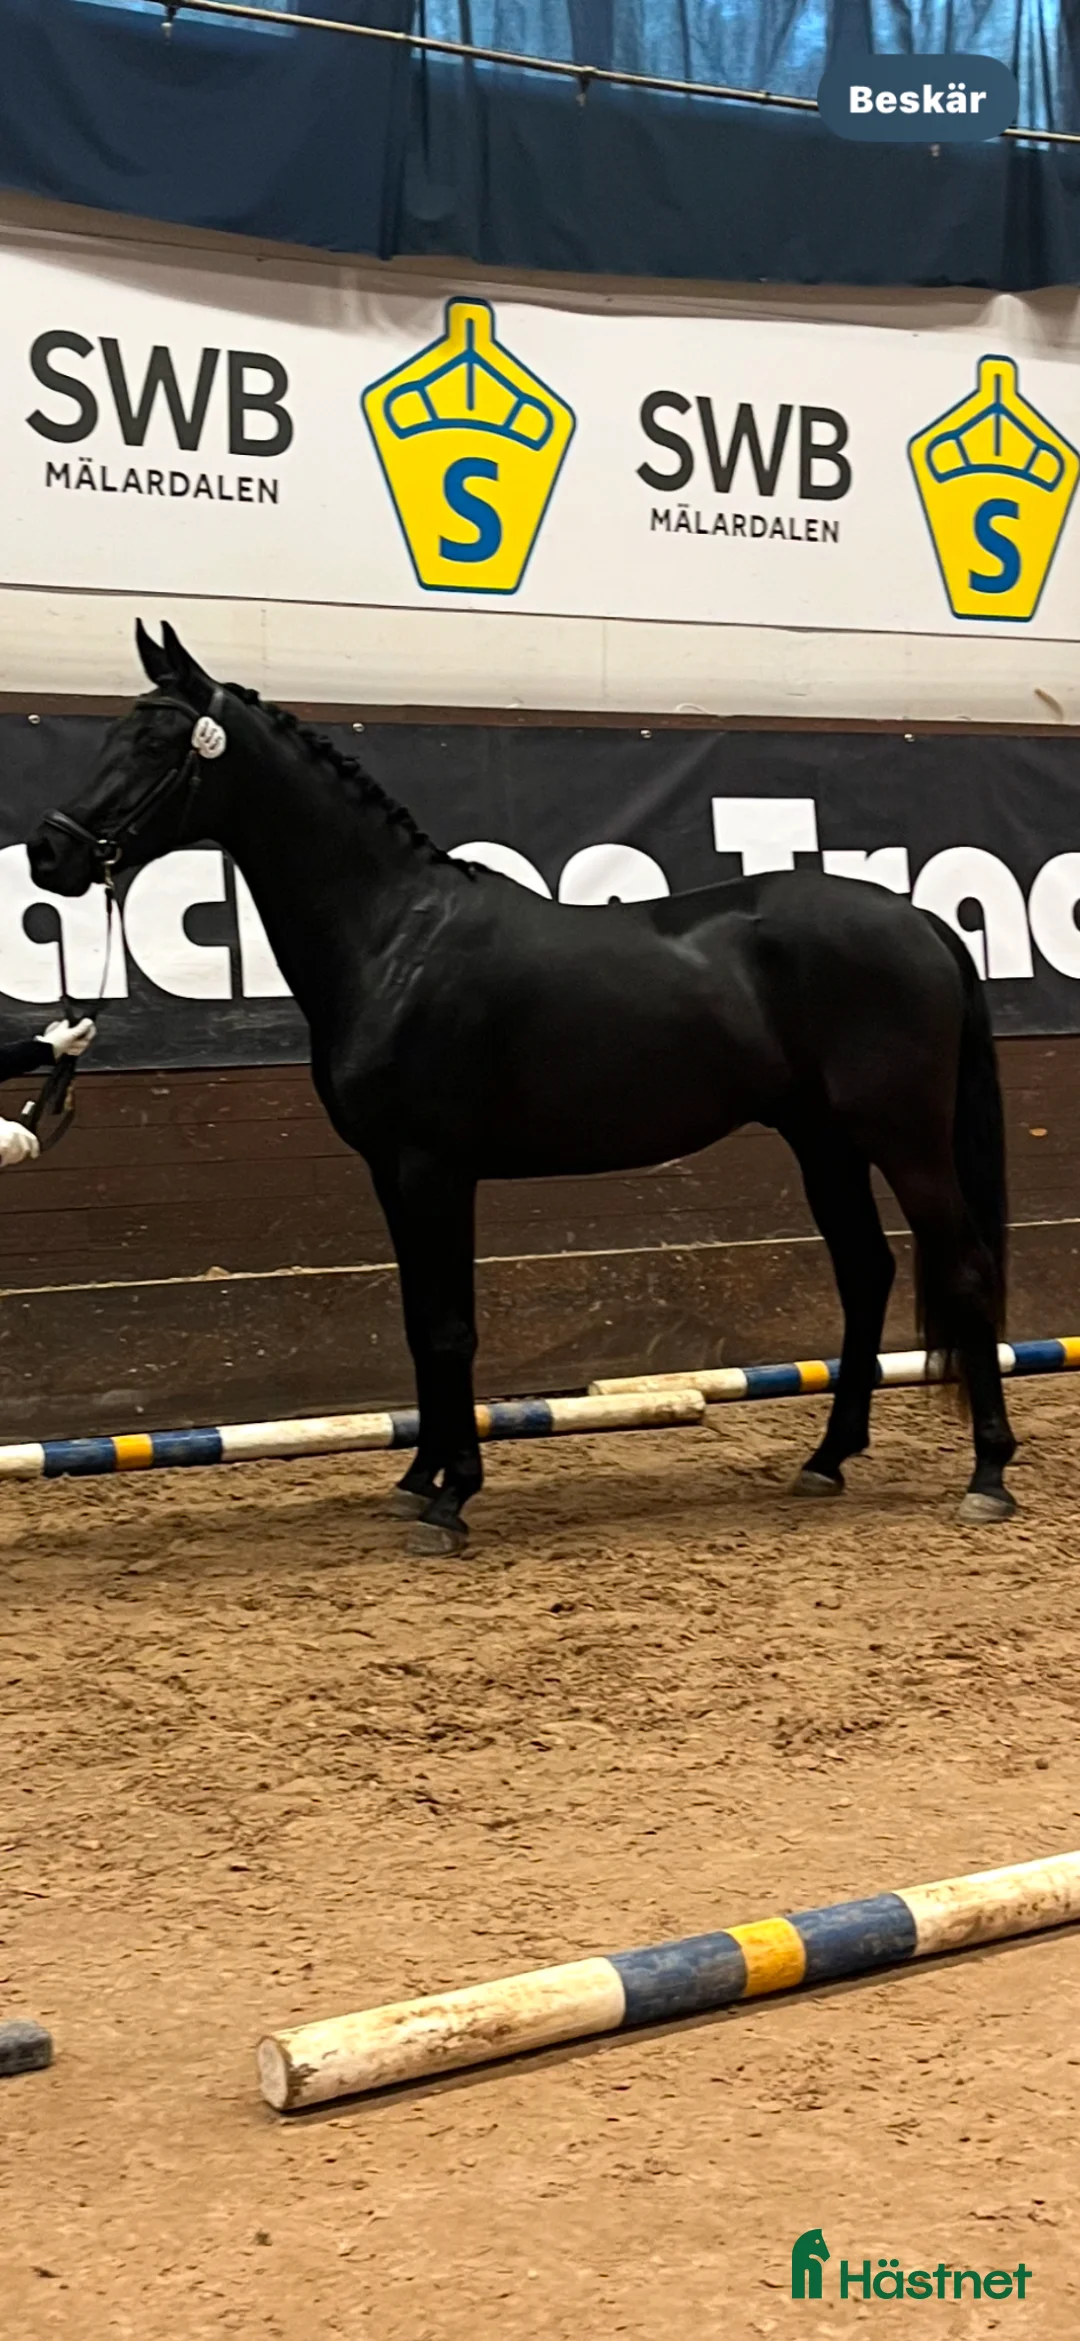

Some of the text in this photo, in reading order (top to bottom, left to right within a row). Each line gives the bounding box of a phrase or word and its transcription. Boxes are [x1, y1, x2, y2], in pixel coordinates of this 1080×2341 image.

[26, 329, 293, 457] SWB
[46, 457, 279, 504] MÄLARDALEN
[636, 390, 852, 501] SWB
[439, 457, 502, 563] S
[650, 502, 840, 543] MÄLARDALEN
[968, 498, 1022, 594] S
